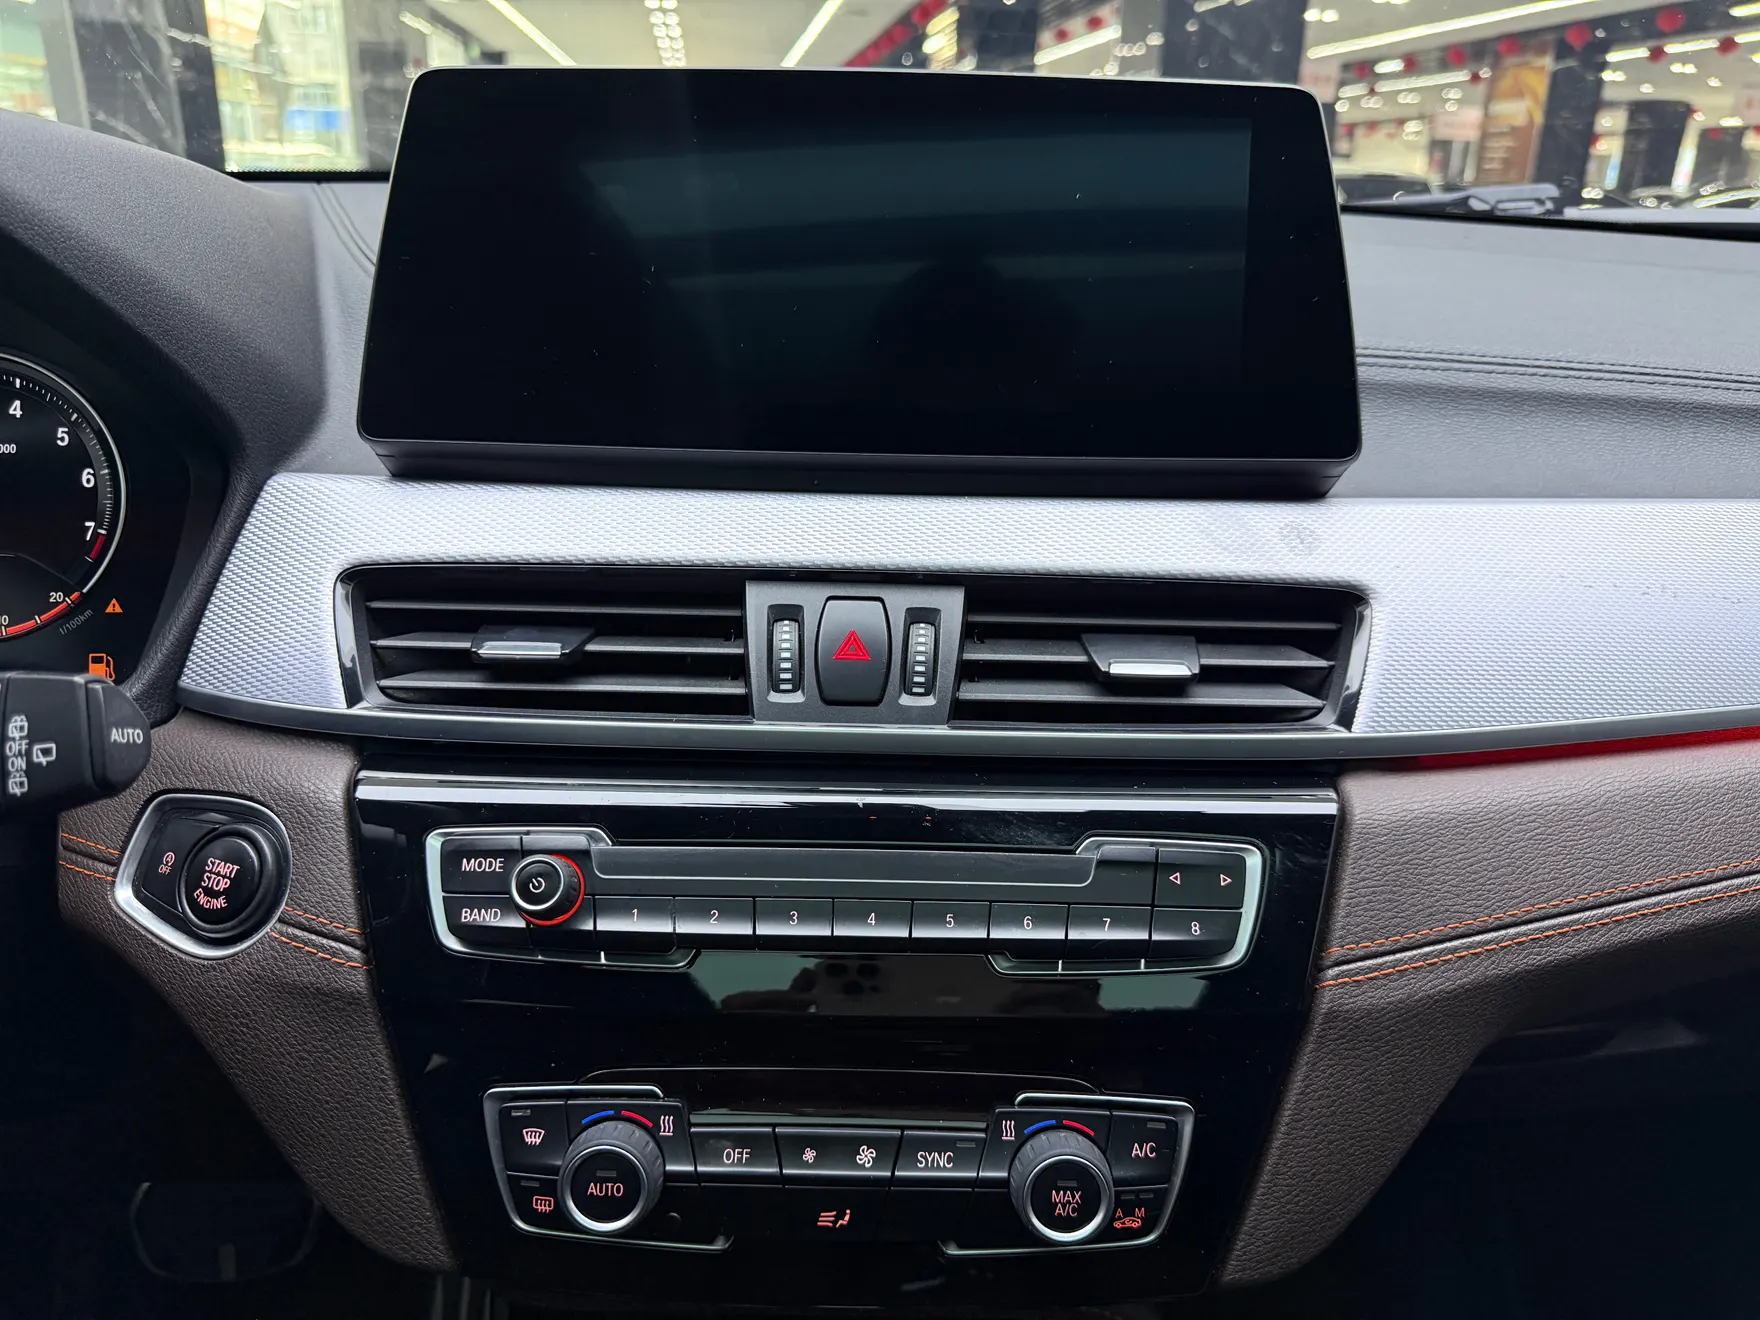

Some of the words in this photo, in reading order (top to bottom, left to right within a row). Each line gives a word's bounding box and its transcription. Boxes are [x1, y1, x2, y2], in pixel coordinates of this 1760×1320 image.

[9, 400, 23, 418] 4
[57, 428, 69, 446] 5
[82, 469, 95, 487] 6
[84, 522, 96, 541] 7
[50, 592, 63, 602] 20
[110, 728, 144, 744] AUTO
[6, 740, 29, 755] OFF
[8, 756, 26, 772] ON
[158, 864, 172, 874] OFF
[205, 857, 240, 878] START
[461, 858, 504, 873] MODE
[201, 872, 230, 892] STOP
[193, 888, 228, 909] ENGINE
[460, 908, 501, 922] BAND
[632, 908, 638, 922] 1
[709, 910, 719, 924] 2
[789, 911, 798, 925] 3
[867, 913, 876, 926] 4
[946, 914, 954, 927] 5
[1023, 916, 1032, 930] 6
[1103, 918, 1111, 931] 7
[1190, 921, 1200, 935] 8
[723, 1148, 751, 1164] OFF
[1131, 1142, 1156, 1158] A/C
[917, 1151, 954, 1168] SYNC
[587, 1183, 624, 1196] AUTO
[1051, 1190, 1081, 1204] MAX
[1054, 1203, 1078, 1217] A/C
[1115, 1207, 1123, 1218] A
[1135, 1207, 1145, 1218] M
